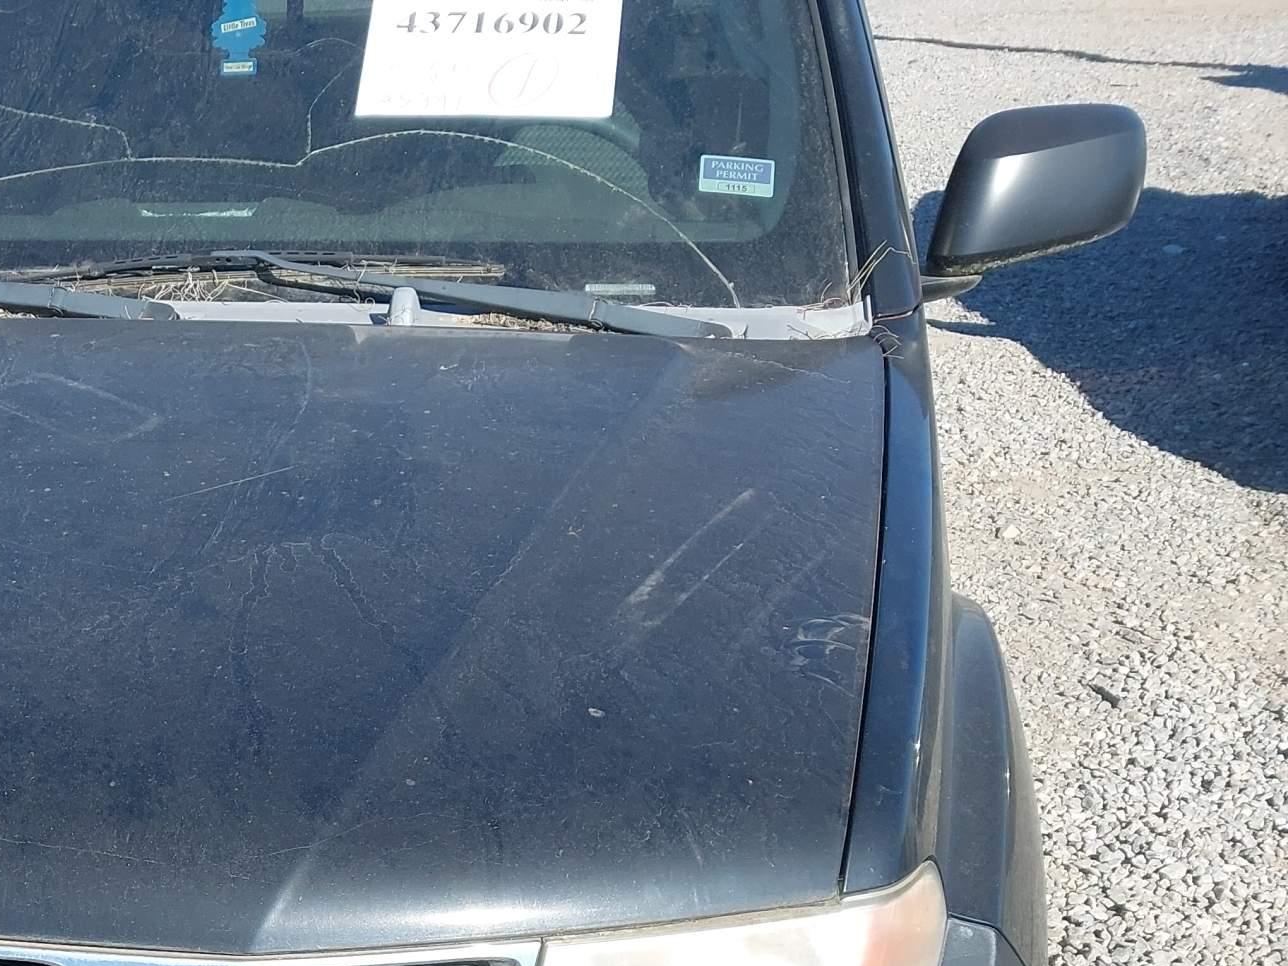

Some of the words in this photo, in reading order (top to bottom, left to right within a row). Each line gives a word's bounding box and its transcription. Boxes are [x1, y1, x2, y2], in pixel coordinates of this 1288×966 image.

[223, 22, 239, 32] Little
[240, 19, 255, 28] Trees
[396, 11, 588, 35] 43716902
[712, 161, 764, 172] PARKING
[716, 170, 759, 181] PERMIT
[726, 183, 748, 193] 1115
